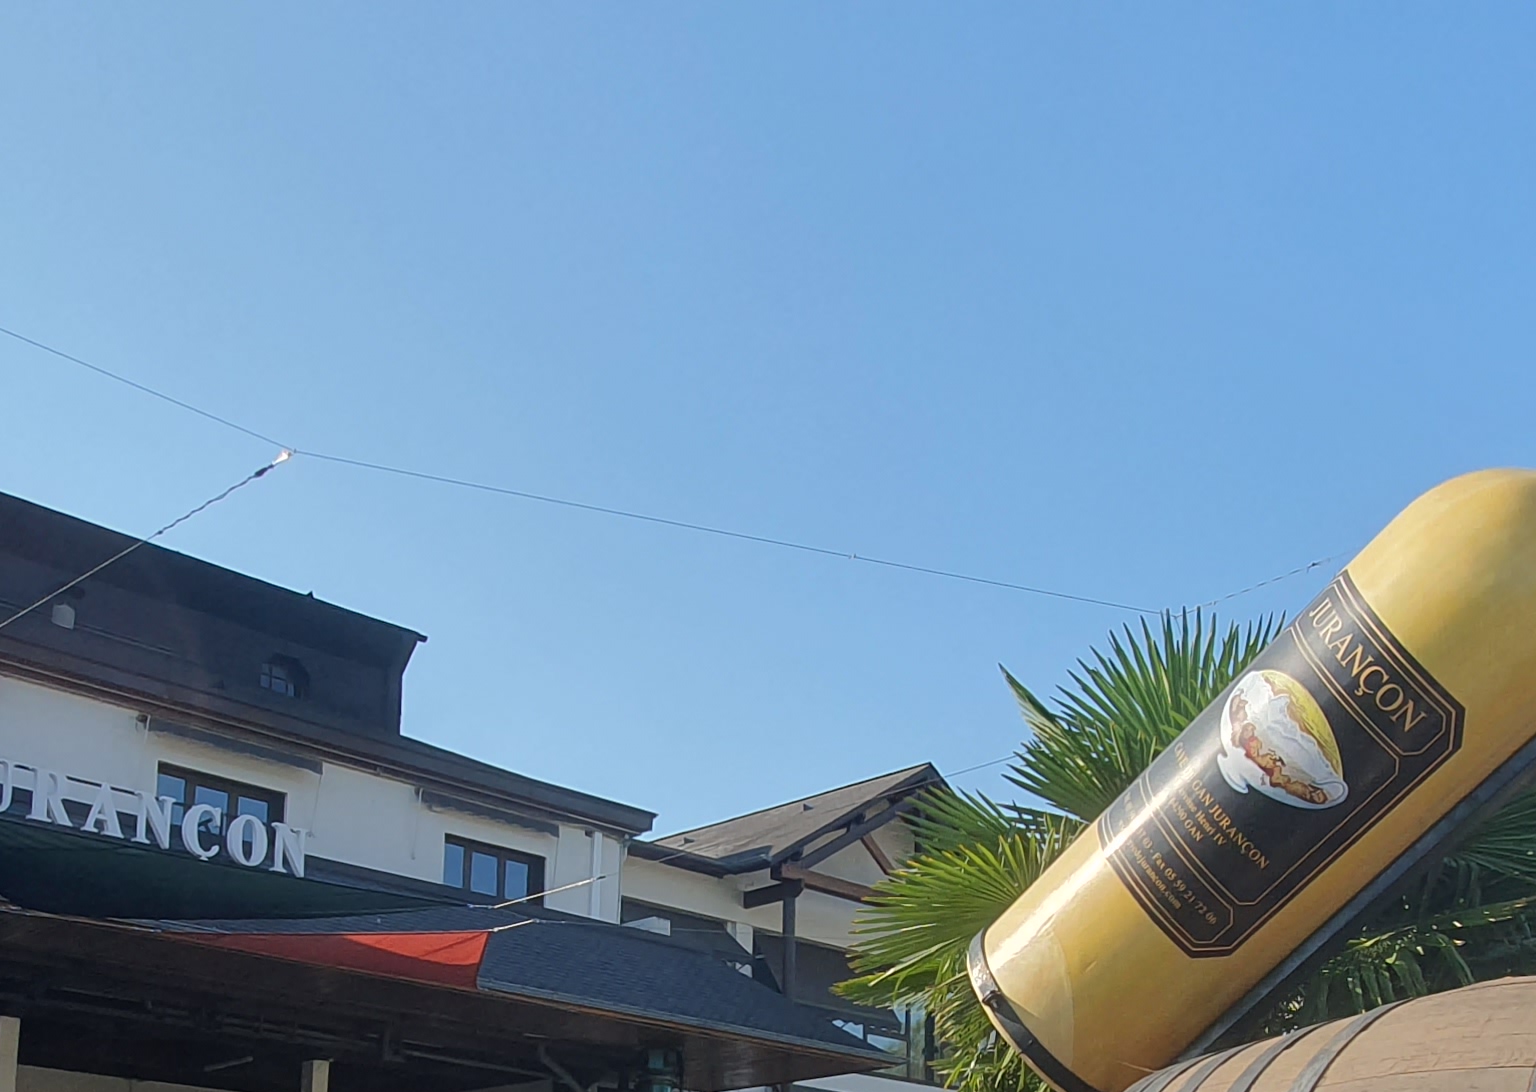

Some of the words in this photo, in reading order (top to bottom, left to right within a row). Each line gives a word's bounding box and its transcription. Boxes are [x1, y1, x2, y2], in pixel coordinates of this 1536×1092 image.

[1307, 596, 1428, 734] JURANÇON
[1182, 817, 1205, 842] GAN
[1191, 778, 1215, 807] GAN
[1207, 803, 1270, 870] JURANÇON
[1193, 809, 1217, 836] Henri
[1211, 831, 1227, 846] IV
